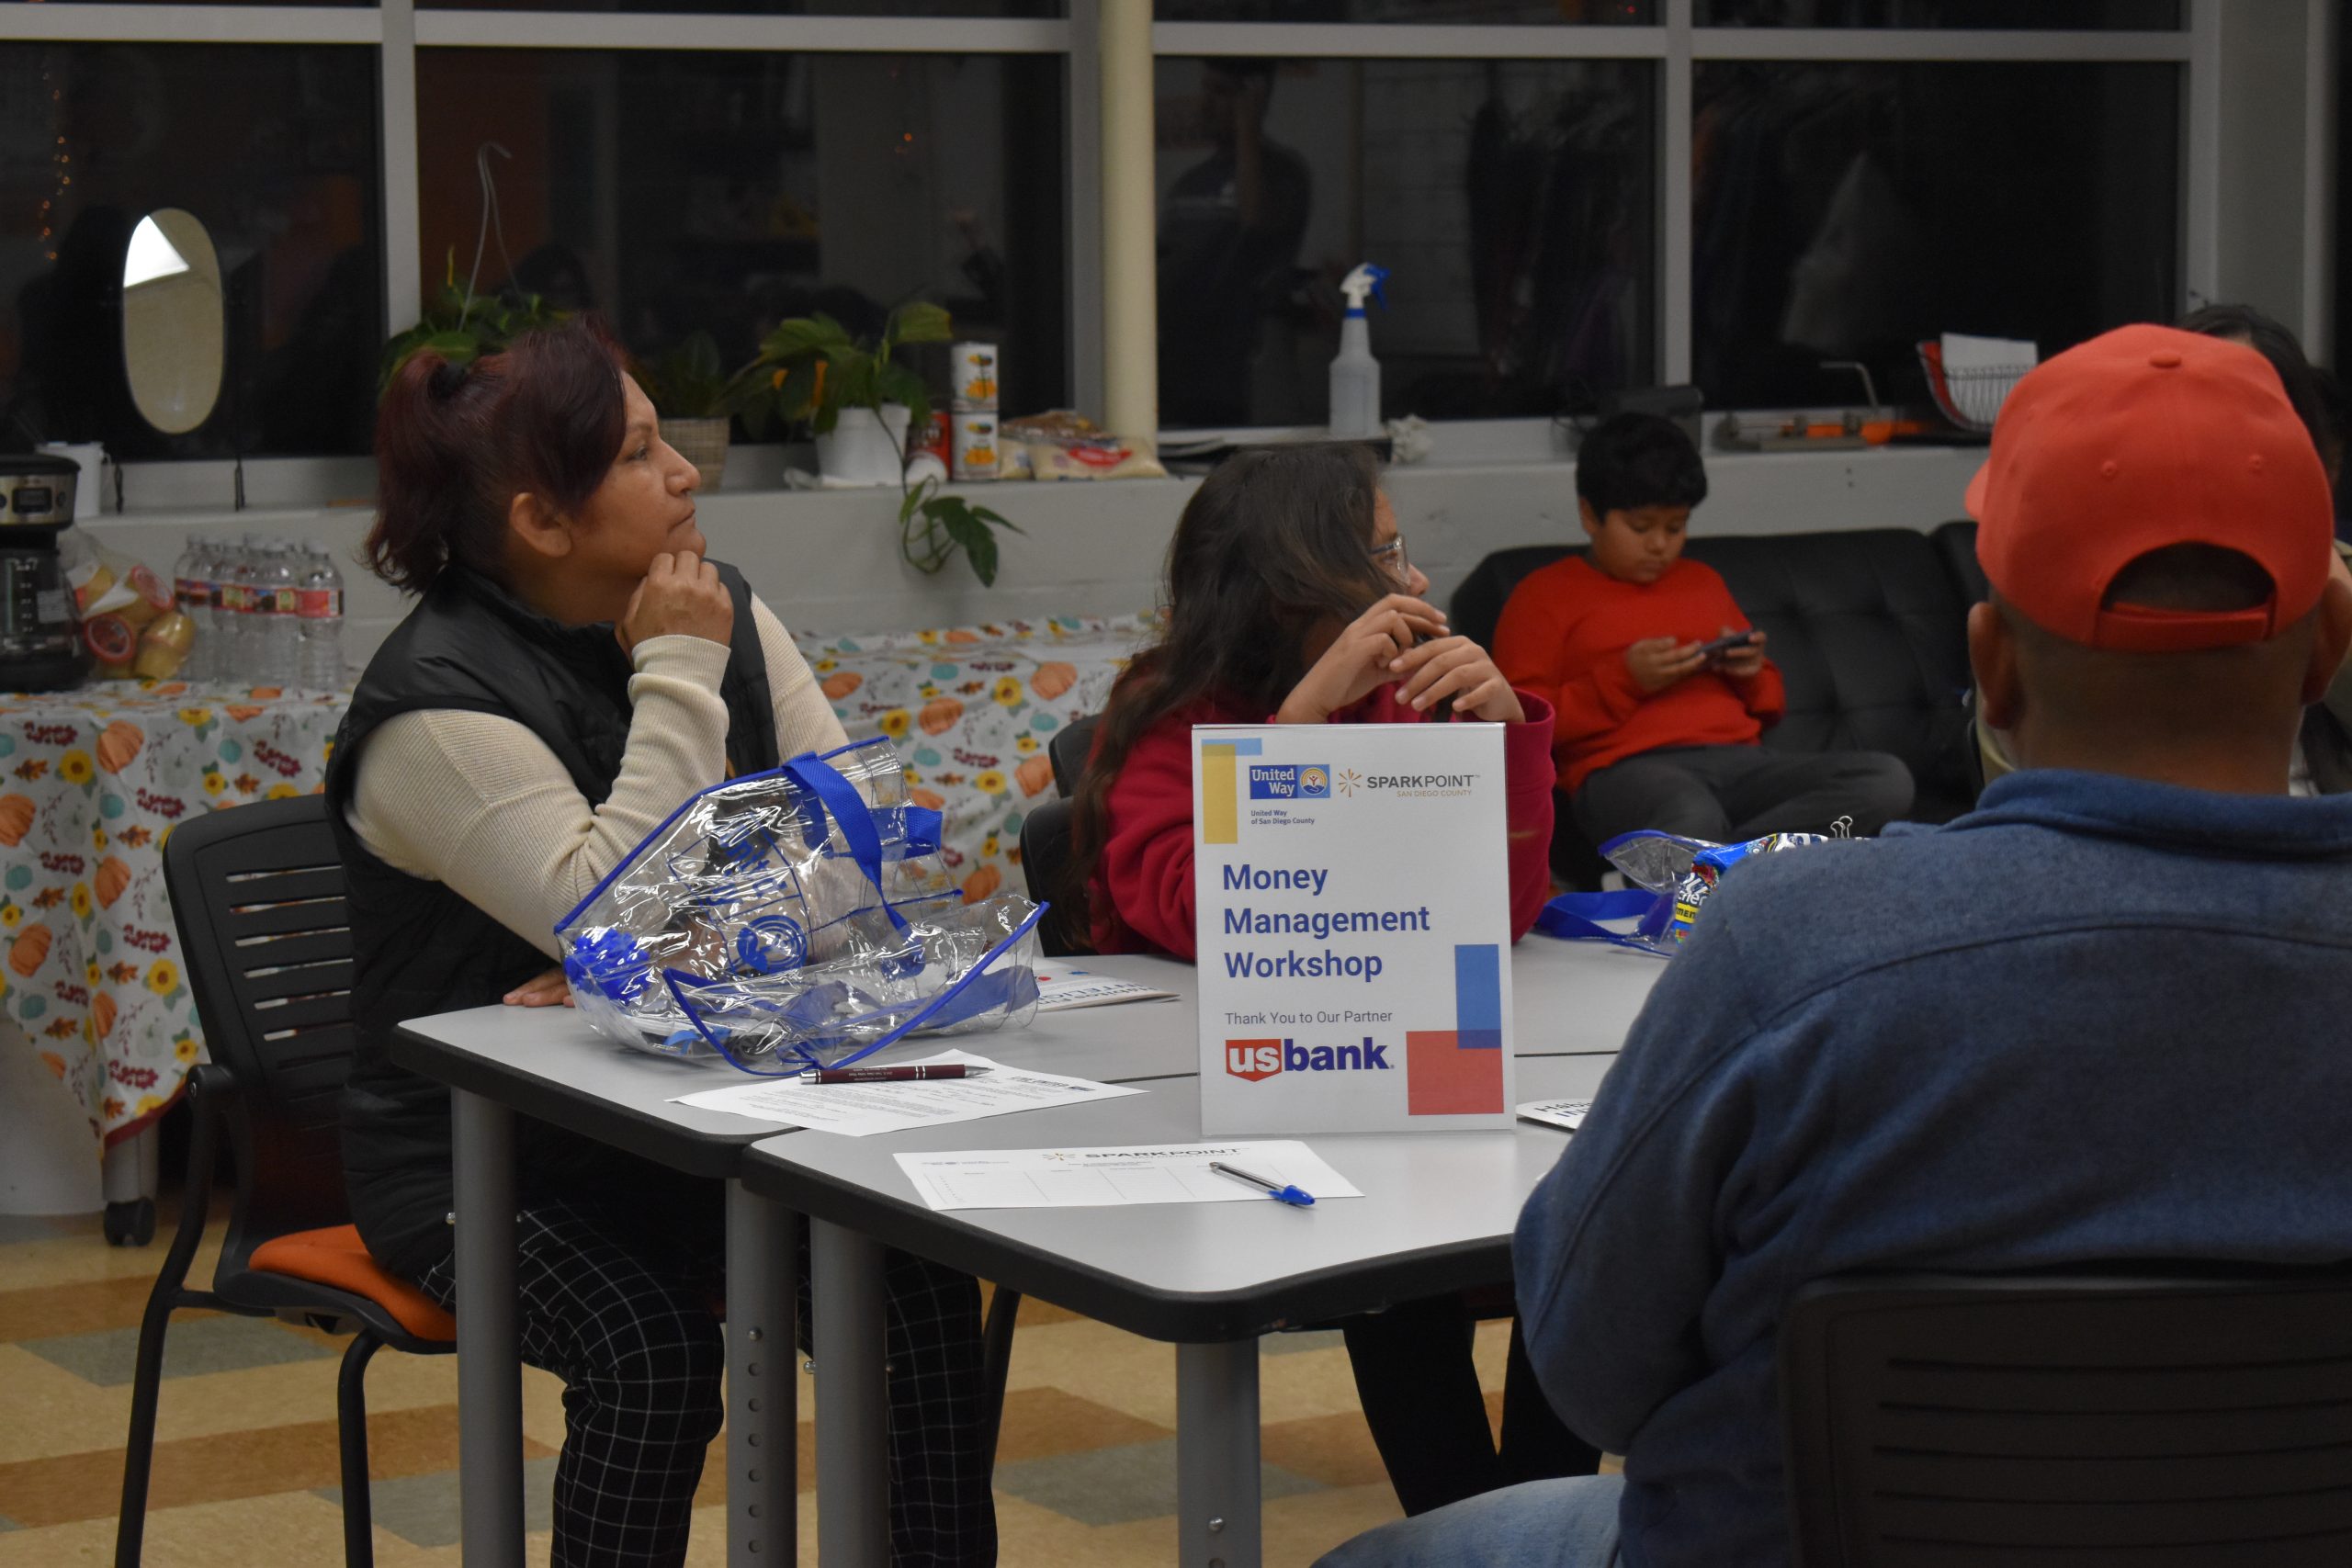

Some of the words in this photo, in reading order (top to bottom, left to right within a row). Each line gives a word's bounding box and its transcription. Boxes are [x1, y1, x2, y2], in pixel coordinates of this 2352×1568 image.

[1251, 768, 1295, 782] United
[1367, 774, 1475, 789] SPARKPOINT
[1268, 782, 1295, 797] Way
[1396, 790, 1413, 798] SAN
[1414, 790, 1440, 798] DIEGO
[1441, 789, 1472, 797] COUNTY
[1250, 818, 1258, 826] of
[1259, 818, 1272, 826] San
[1272, 818, 1291, 826] Diego
[1292, 817, 1315, 826] County
[1273, 810, 1287, 818] Way
[1223, 863, 1329, 897] Money
[1224, 906, 1430, 940] Management
[1224, 949, 1383, 983] Workshop
[1226, 1012, 1266, 1025] Thank
[1270, 1011, 1296, 1024] You
[1300, 1012, 1313, 1024] to
[1317, 1011, 1340, 1023] Our
[1344, 1010, 1393, 1023] Partner
[1085, 1148, 1242, 1158] SPARKPOINT
